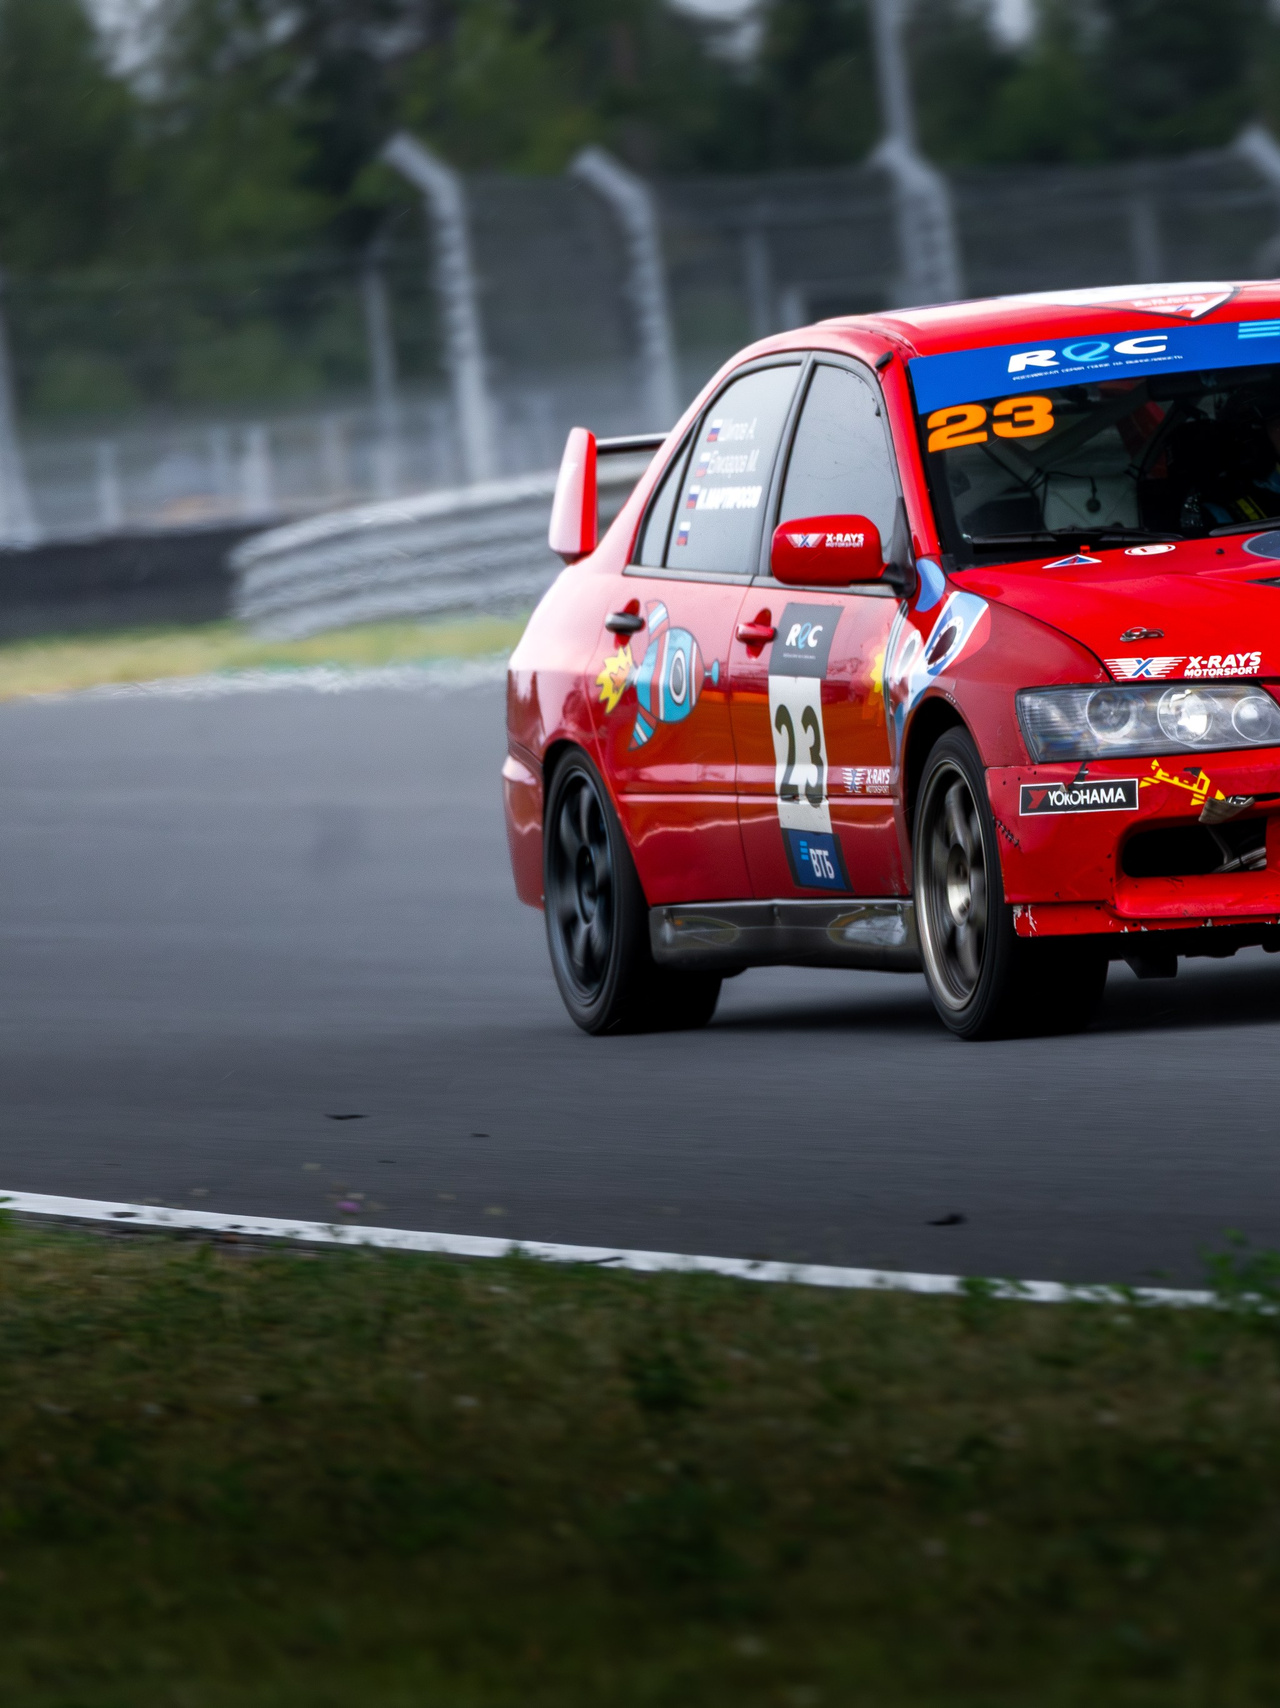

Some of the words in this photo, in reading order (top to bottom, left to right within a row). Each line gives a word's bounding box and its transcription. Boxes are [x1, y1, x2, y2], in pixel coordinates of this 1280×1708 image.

[927, 395, 1055, 453] 23
[1184, 665, 1260, 677] MOTORSPORT
[1186, 651, 1262, 669] X-RAYS
[775, 703, 824, 808] 23
[1048, 787, 1126, 807] YOKOHAMA
[809, 848, 835, 879] ВТБ
